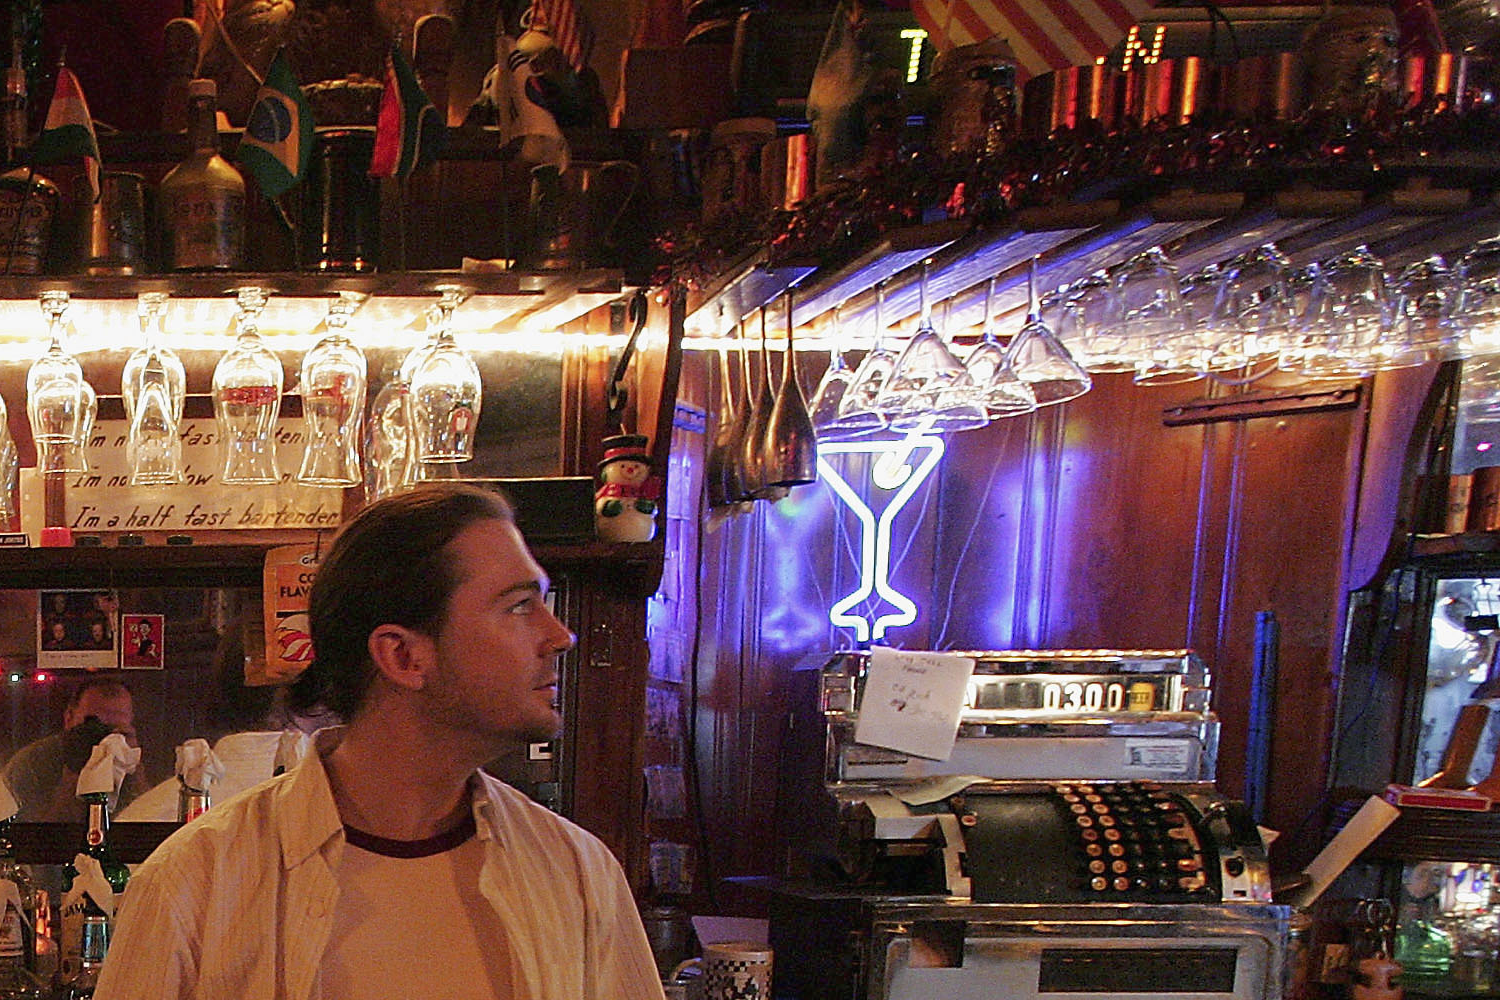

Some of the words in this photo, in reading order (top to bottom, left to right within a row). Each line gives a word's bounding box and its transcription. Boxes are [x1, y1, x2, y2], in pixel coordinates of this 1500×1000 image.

[71, 505, 102, 528] I'm
[107, 515, 120, 527] a
[124, 504, 175, 528] half
[184, 503, 232, 527] fast
[280, 586, 311, 598] FLAV
